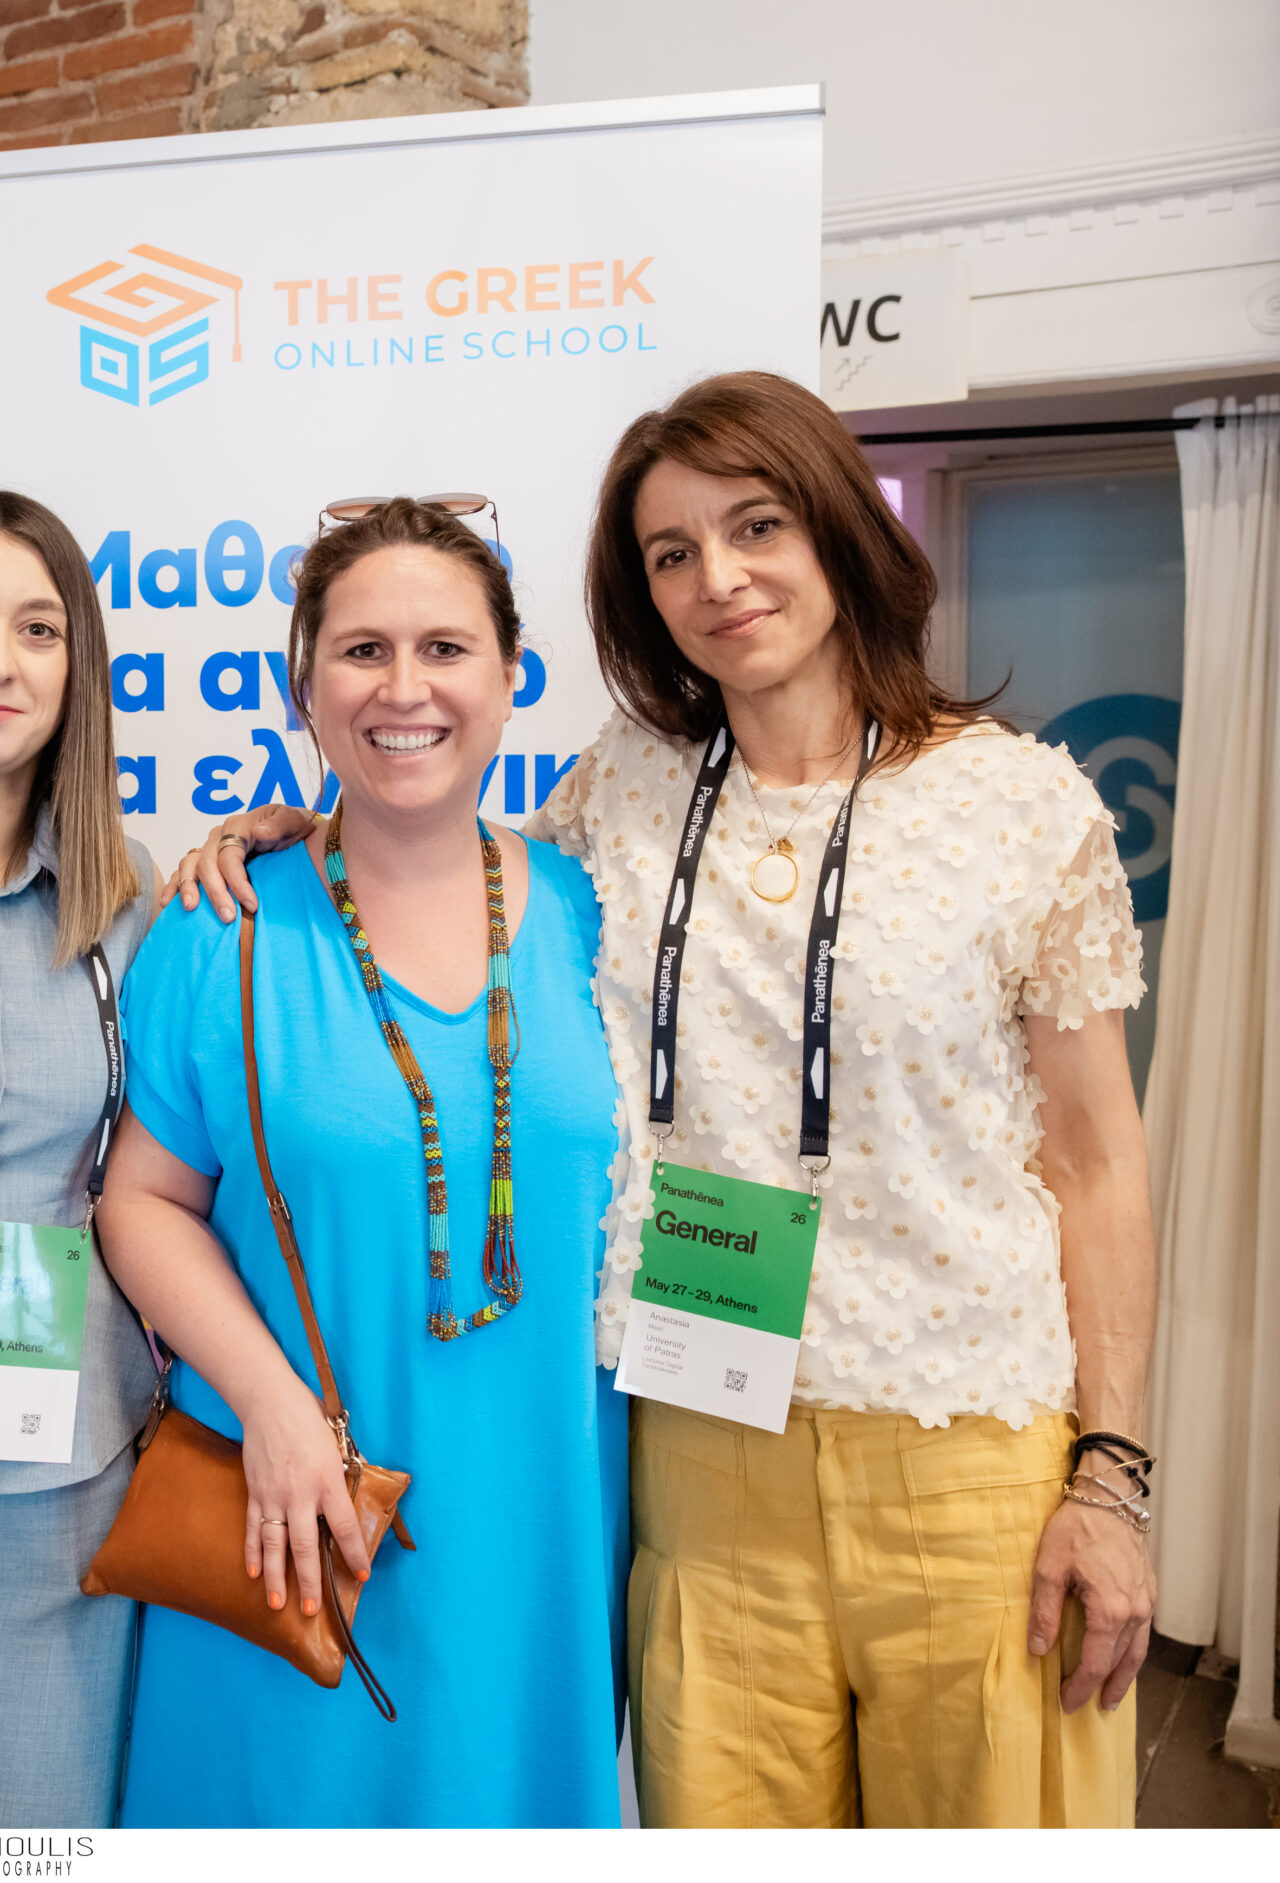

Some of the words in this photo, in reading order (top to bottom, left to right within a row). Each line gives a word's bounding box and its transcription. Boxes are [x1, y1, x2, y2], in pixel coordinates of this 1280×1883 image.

[274, 273, 403, 326] THE
[425, 255, 658, 318] GREEK
[820, 294, 902, 348] WC
[274, 334, 445, 371] ONLINE
[462, 322, 658, 360] SCHOOL
[789, 1212, 807, 1225] 26
[655, 1209, 758, 1255] General
[67, 1250, 80, 1261] 26
[646, 1276, 670, 1295] May
[715, 1294, 758, 1314] Athens
[649, 1311, 690, 1328] Anastasia
[6, 1340, 43, 1353] Athens
[646, 1333, 687, 1351] University
[644, 1344, 653, 1353] of
[654, 1345, 681, 1360] Patras
